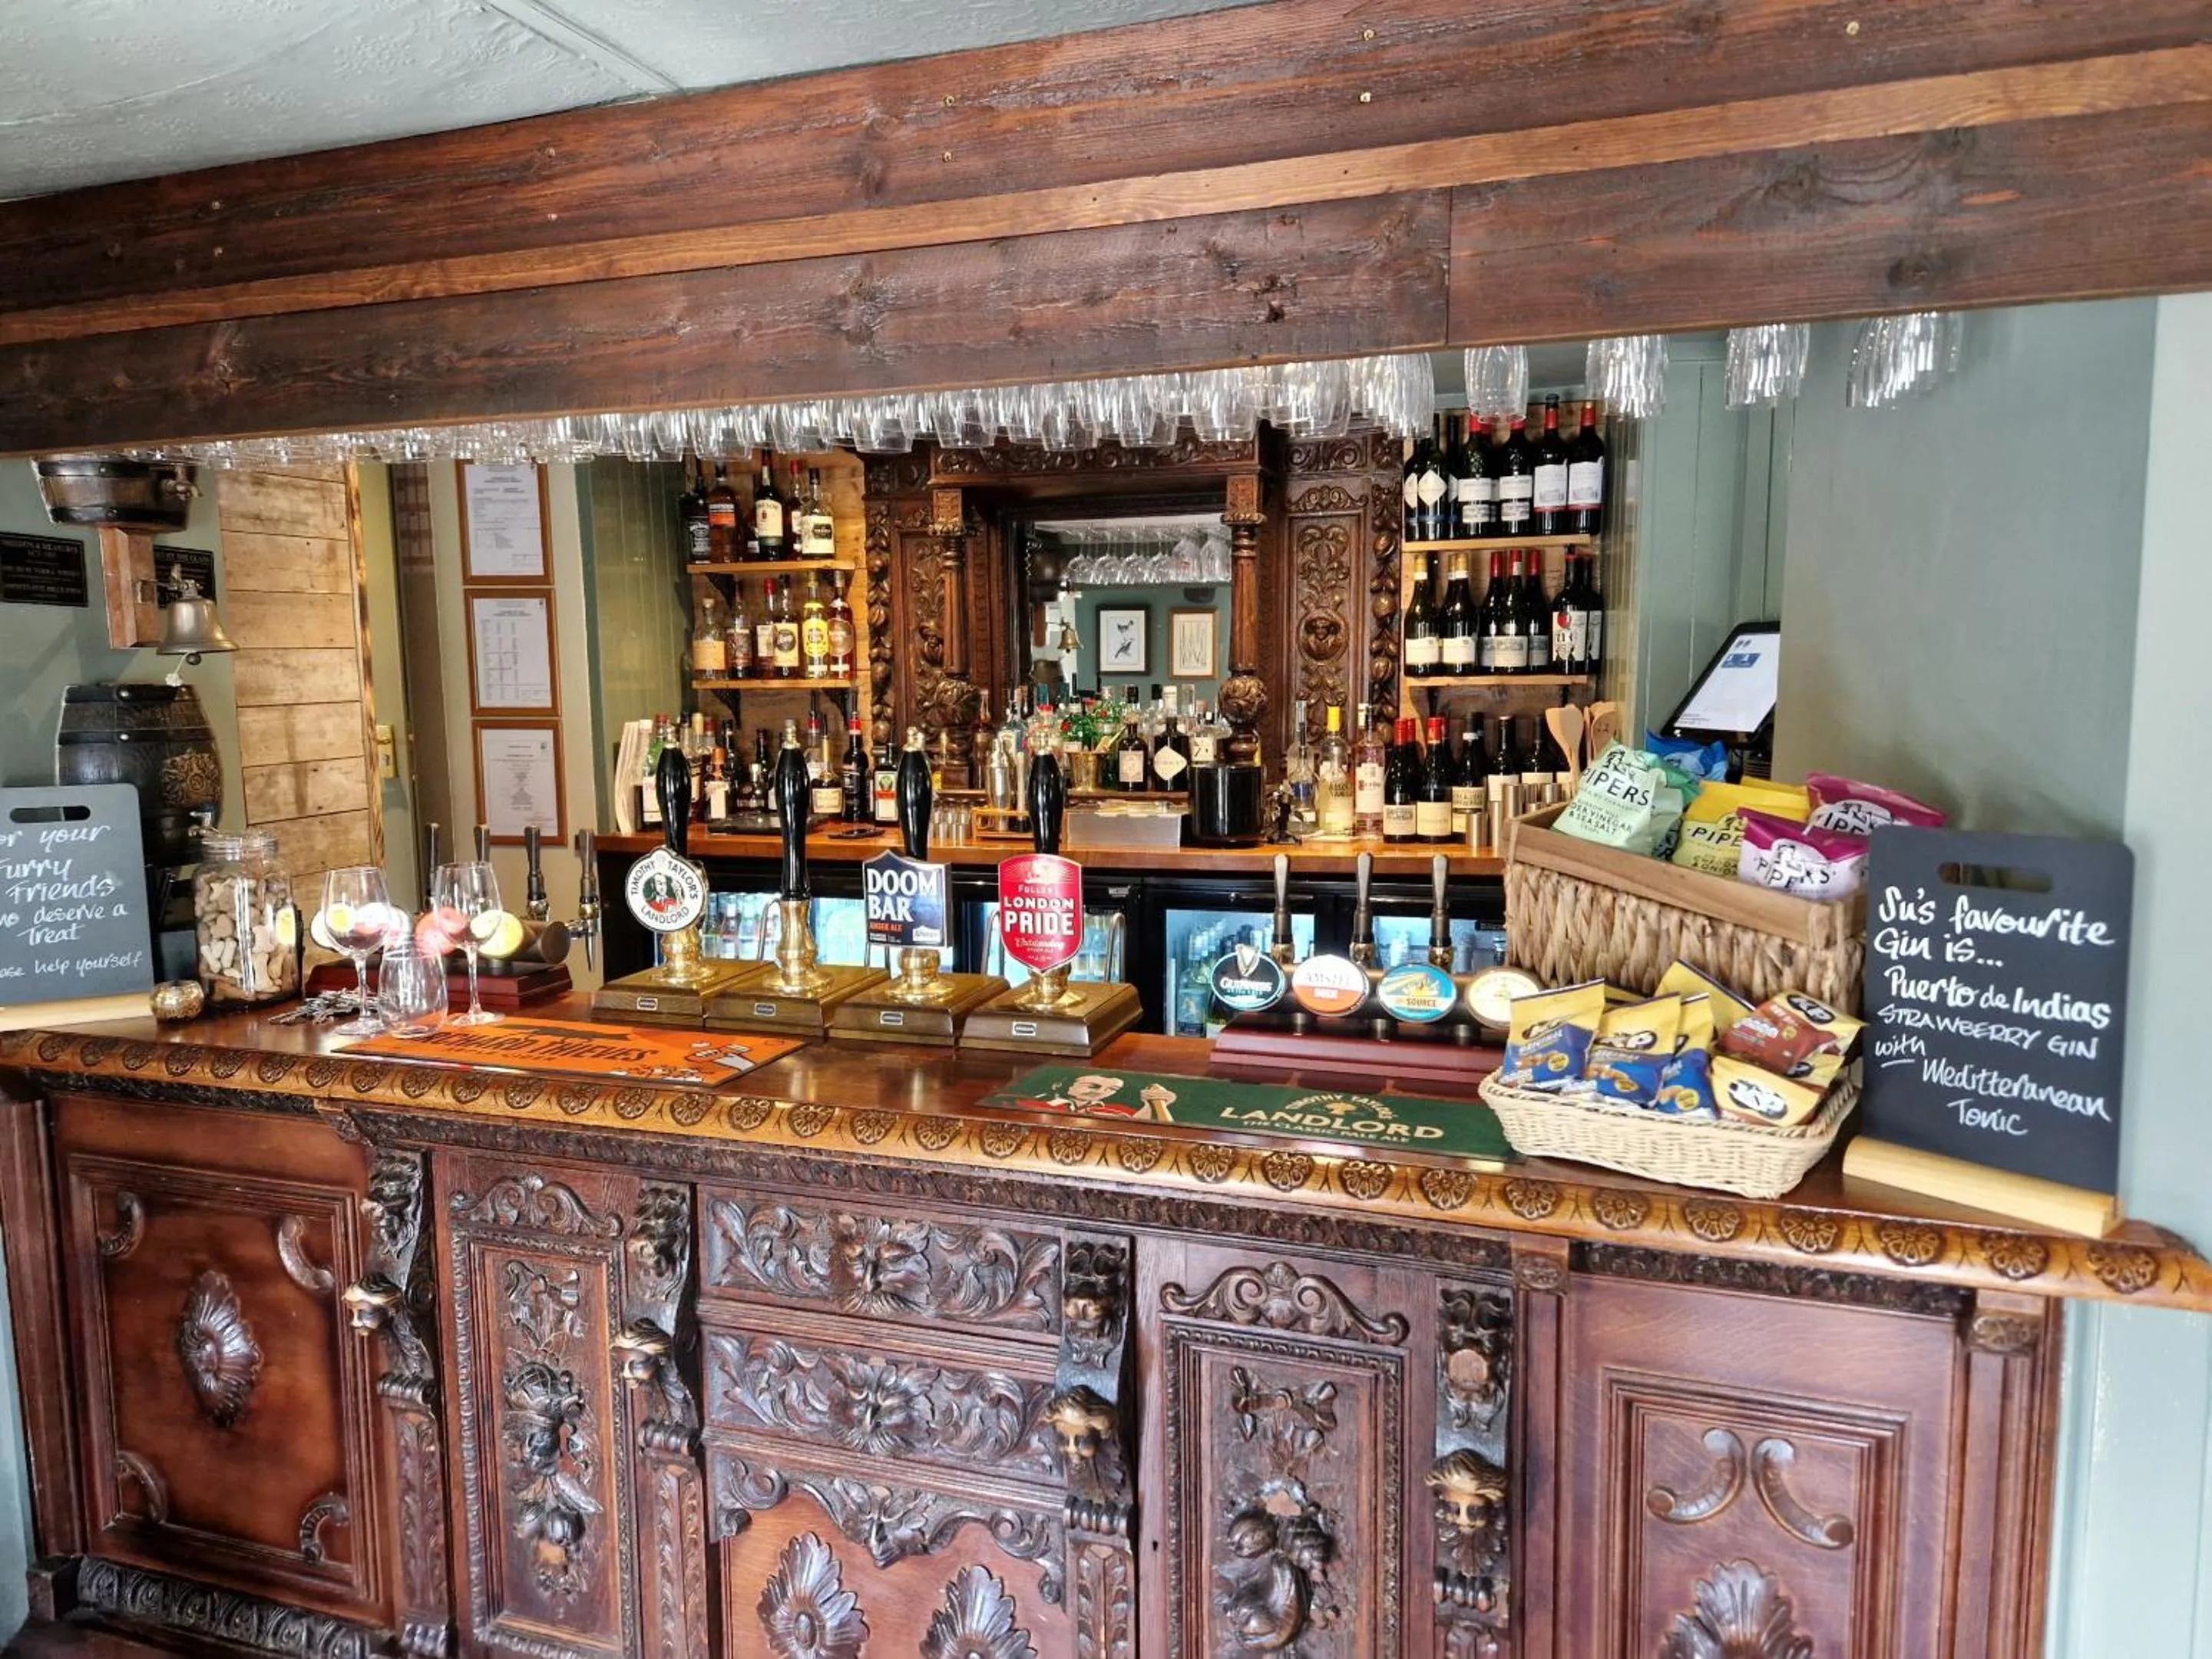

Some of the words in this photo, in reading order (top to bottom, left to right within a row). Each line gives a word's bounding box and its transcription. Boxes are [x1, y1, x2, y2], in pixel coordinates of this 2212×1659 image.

[39, 825, 111, 853] your
[1691, 827, 1741, 847] PIPE
[5, 874, 115, 904] Friends
[631, 861, 655, 895] TIMOTHY
[668, 861, 698, 900] TAYLOR'S
[867, 868, 937, 896] DOOM
[34, 904, 105, 925] deserve
[113, 904, 129, 917] a
[641, 906, 689, 924] LANDLORD
[868, 894, 915, 921] BAR
[1004, 896, 1074, 909] LONDON
[1878, 886, 1936, 925] Su's
[1949, 895, 2116, 946] favourite
[16, 923, 86, 946] Treat
[1004, 910, 1074, 936] PRIDE
[1874, 927, 1932, 960] Gin
[1943, 934, 2003, 967] is...
[35, 960, 70, 975] help
[77, 951, 142, 977] yourself
[1406, 997, 1437, 1008] SOURCE
[1884, 965, 1979, 1007] Puerto
[1979, 985, 2009, 1009] de
[2013, 987, 2113, 1029] Indias
[1877, 1004, 2042, 1049] STRAWBERRY
[2047, 1035, 2100, 1059] GIN
[1875, 1034, 1926, 1058] with
[1220, 1107, 1444, 1139] LANDLORD
[1947, 1098, 2028, 1135] Tonic
[1275, 1122, 1336, 1135] CLASSIC
[1341, 1131, 1377, 1140] PALE
